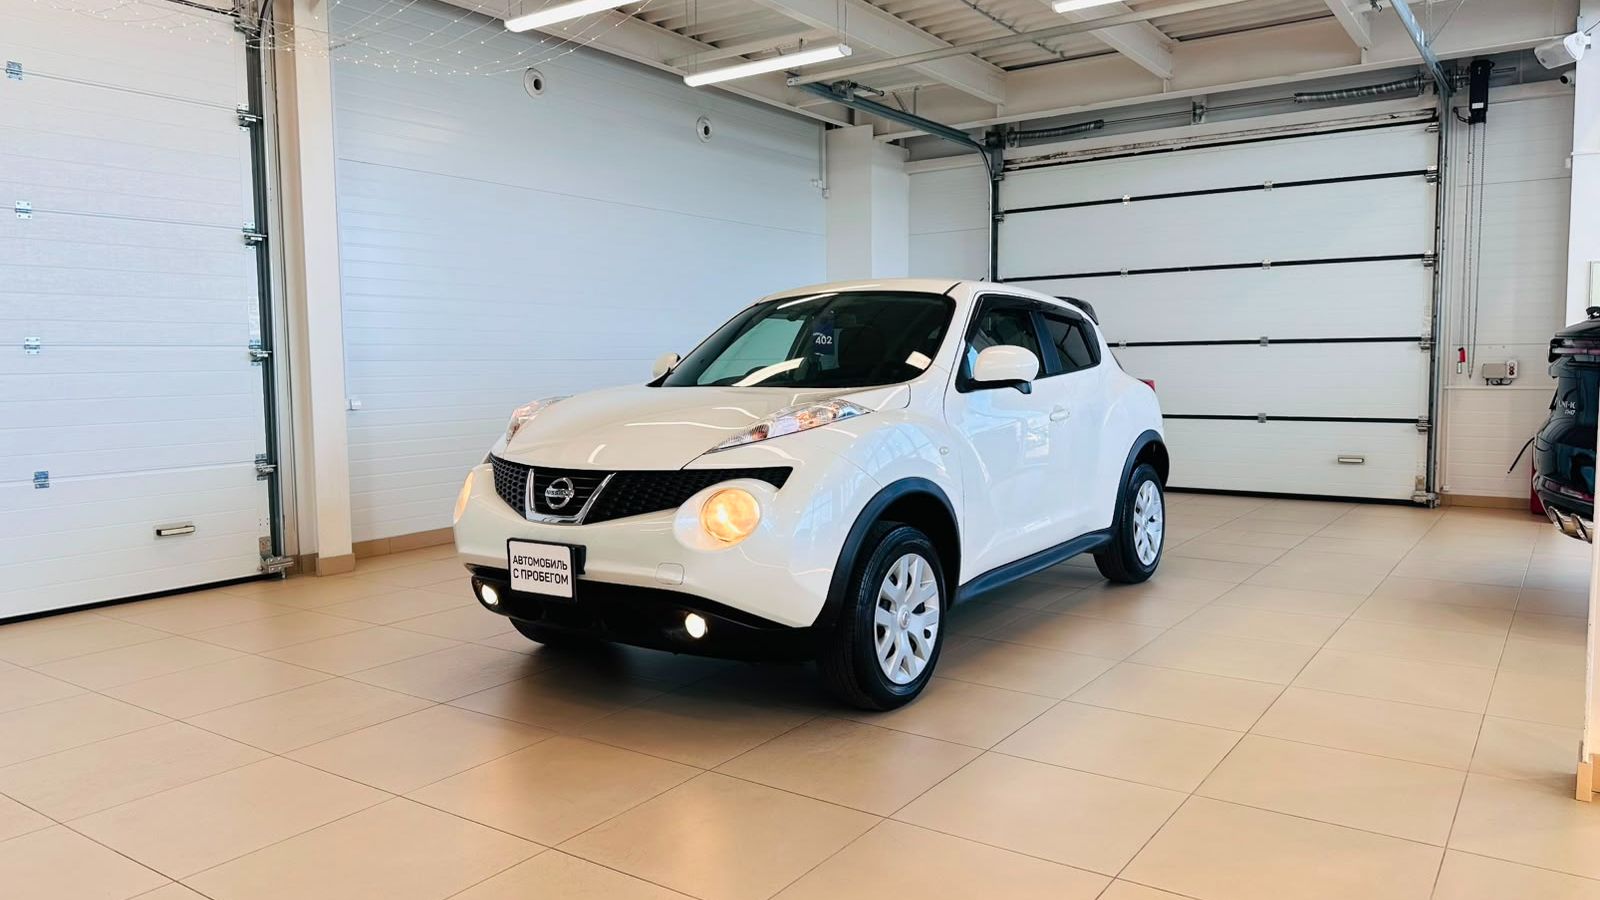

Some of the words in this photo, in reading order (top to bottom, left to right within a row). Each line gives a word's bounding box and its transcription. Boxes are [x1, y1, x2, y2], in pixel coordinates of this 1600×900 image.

[815, 335, 833, 345] 402
[513, 555, 568, 570] АВТОМОБИЛЬ
[513, 568, 519, 578] С
[521, 569, 569, 585] ПРОБЕГОМ
